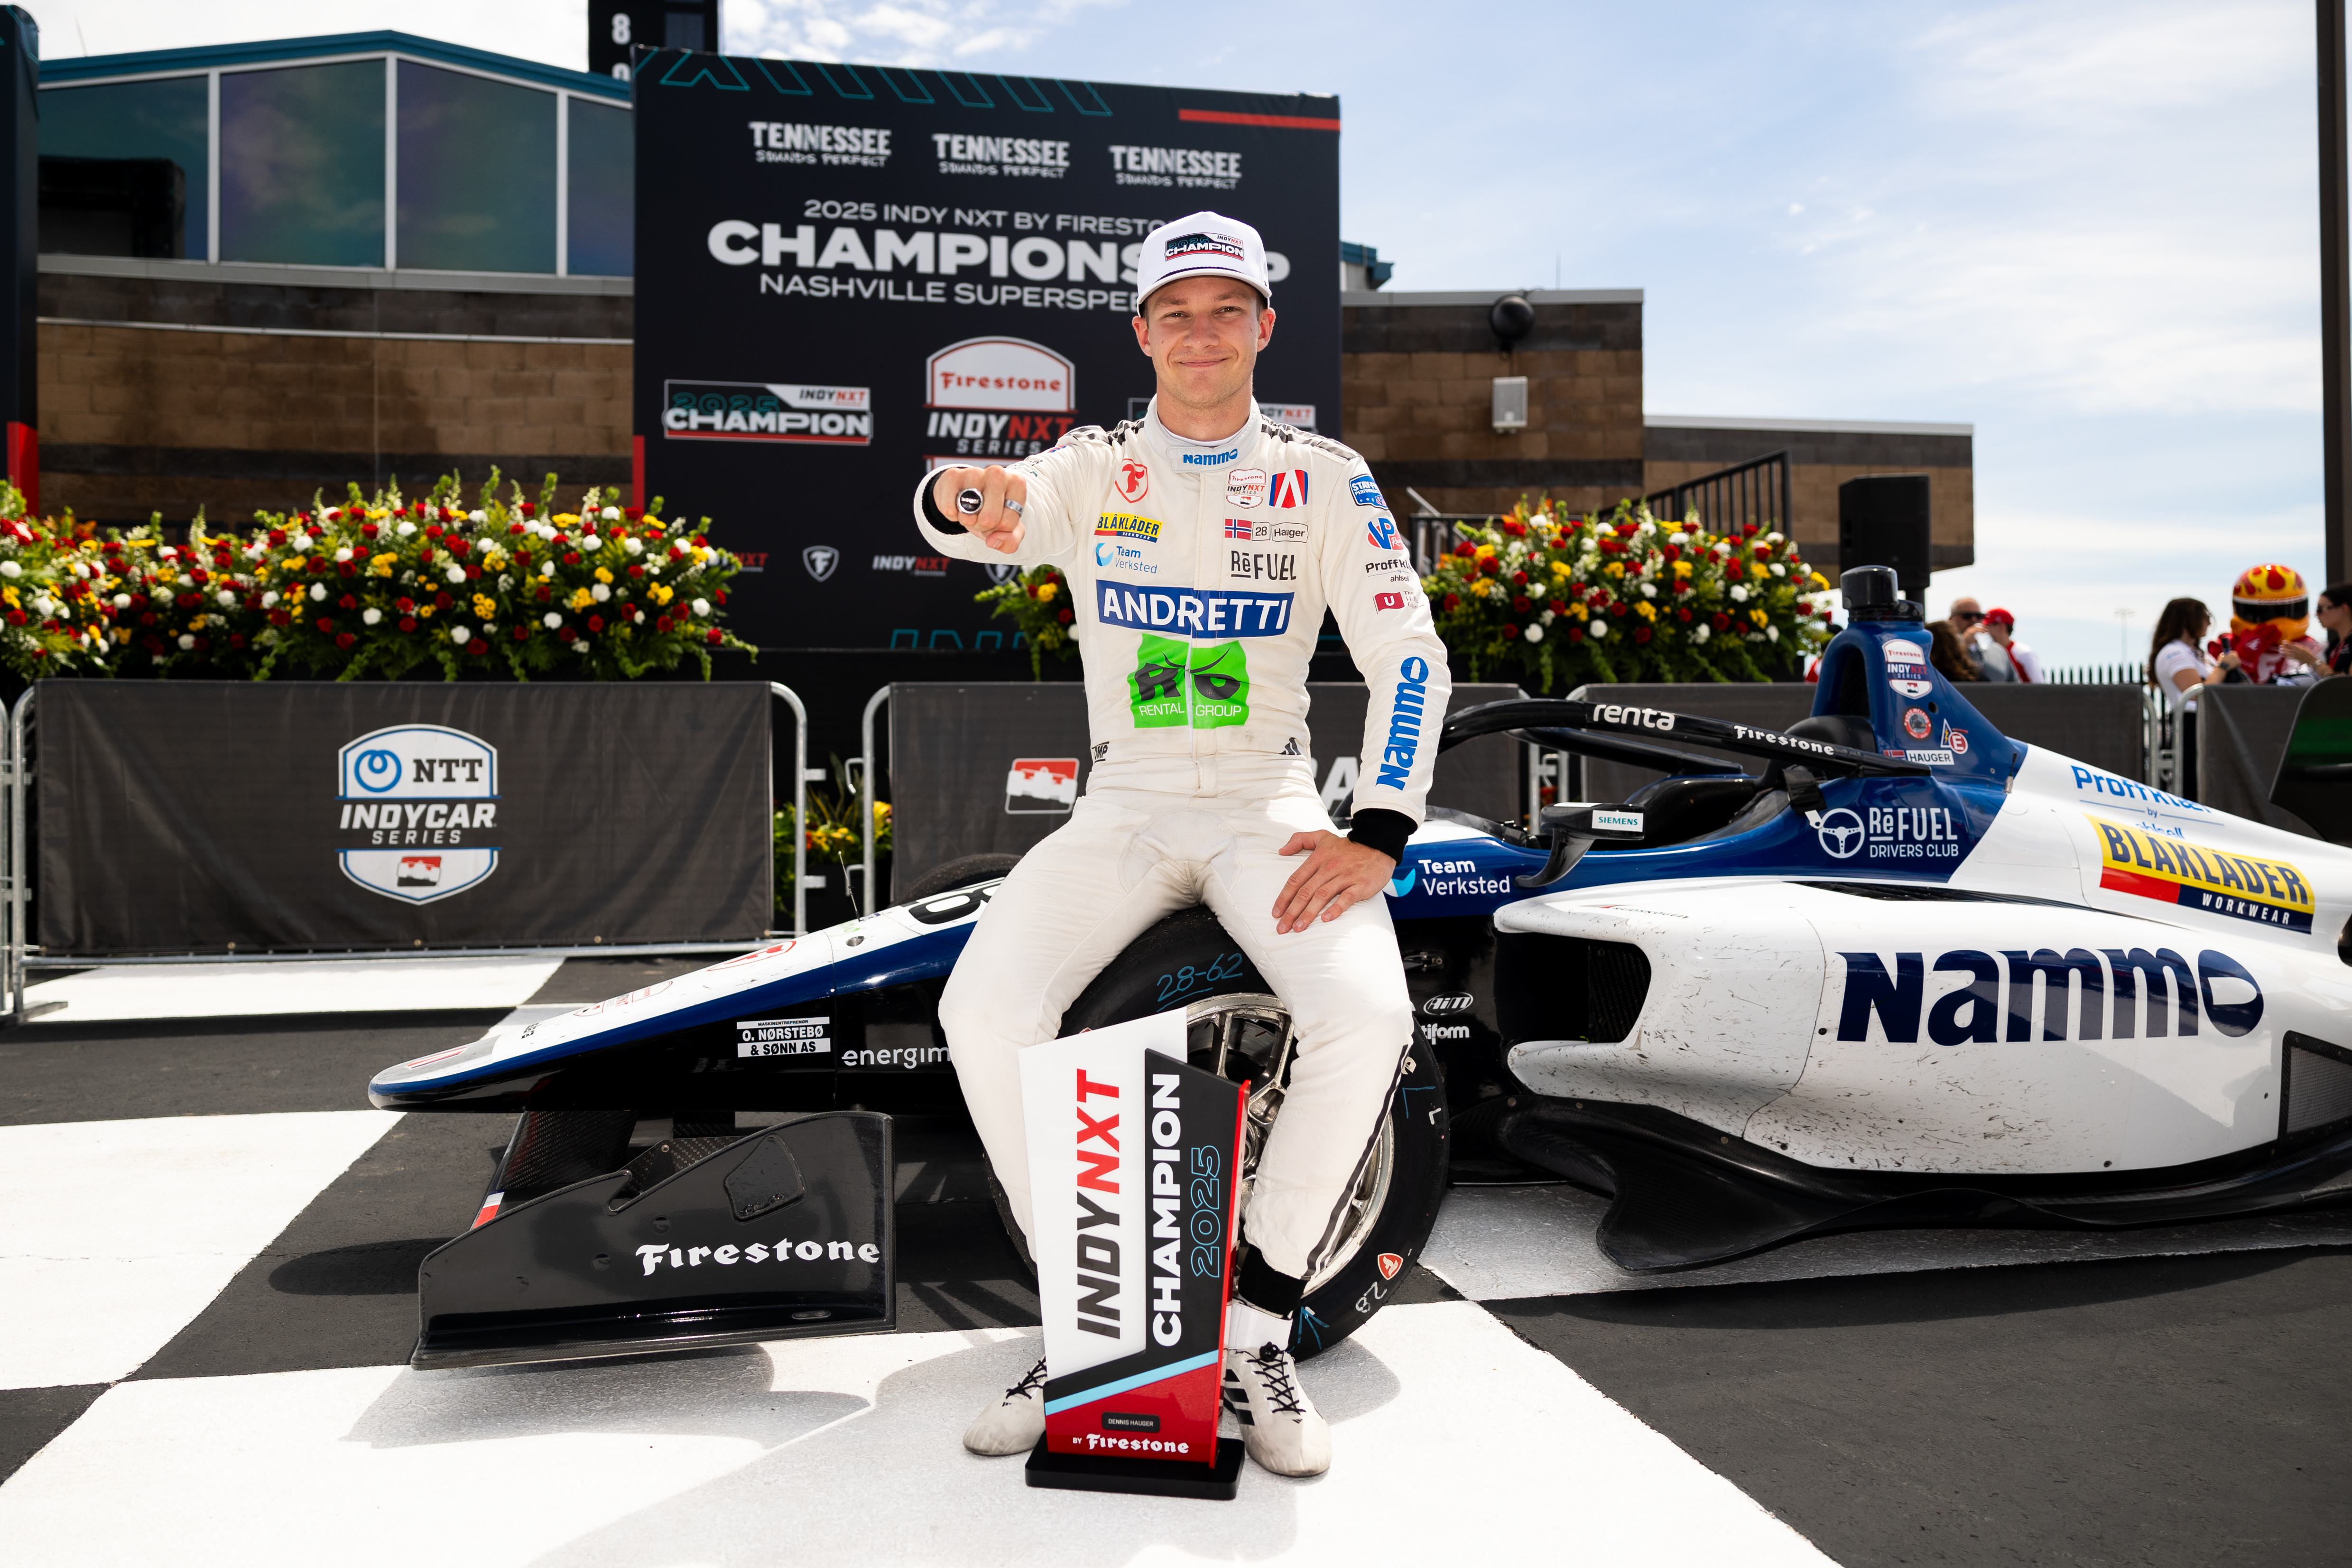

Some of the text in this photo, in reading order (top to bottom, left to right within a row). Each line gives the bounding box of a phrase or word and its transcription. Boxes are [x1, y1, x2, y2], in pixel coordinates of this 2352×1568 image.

[612, 13, 631, 45] 8
[749, 121, 892, 156] TENNESSEE
[755, 150, 888, 168] SOUNDS PERFECT
[932, 133, 1070, 167] TENNESSEE
[939, 161, 1066, 179] SOUNDS PERFECT
[1109, 145, 1242, 179] TENNESSEE
[1115, 172, 1238, 190] SOUNDS PERFECT
[804, 199, 1163, 235] 2025 INDY NXT BY FIRESTO
[1166, 242, 1244, 258] CHAMPION
[1168, 237, 1210, 249] 2025
[1217, 235, 1242, 245] INDYNXT
[707, 220, 1291, 284] CHAMPION
[760, 273, 1139, 313] NASHVILLE SUPERSPEE
[940, 371, 1062, 392] Firestone
[672, 392, 781, 417] 2025
[800, 388, 866, 400] INDYNXT
[665, 408, 869, 436] CHAMPION
[926, 412, 1074, 441] INDYNXT
[956, 439, 1042, 455] SERIES
[1183, 448, 1238, 466] Nammo
[1097, 514, 1159, 536] BLÅKLÄDER
[1255, 526, 1305, 538] 28 Hauger
[1368, 518, 1395, 549] VP
[1122, 532, 1150, 540] WORKWEAR
[1116, 546, 1141, 558] Team
[1115, 557, 1157, 574] Verksted
[1365, 559, 1413, 573] Proffkl
[1103, 588, 1288, 631] ANDRETTI
[1384, 595, 1396, 607] U
[1888, 664, 1928, 674] INDYNXT
[1139, 703, 1242, 716] RENTAL GROUP
[1593, 704, 1676, 731] renta
[1375, 657, 1429, 791] Nammo
[1733, 724, 1835, 755] Firestone
[1952, 735, 1964, 750] E
[1909, 753, 1951, 761] HAUGER
[413, 759, 482, 783] NTT
[340, 803, 496, 829] INDYCAR
[1598, 816, 1638, 826] SIEMENS
[2147, 807, 2158, 818] by
[371, 830, 462, 844] SERIES
[1870, 844, 1959, 857] DRIVERS CLUB
[1418, 859, 1476, 874] Team
[1422, 875, 1510, 896] Verksted
[2203, 892, 2290, 925] WORKWEAR
[1157, 953, 1243, 1002] 28-62
[1835, 947, 2264, 1047] Nammo
[742, 1025, 824, 1041] O. NØRSTEBØ
[1421, 1023, 1470, 1045] tiform
[750, 1041, 816, 1056] & SØNN AS
[842, 1047, 952, 1069] energim
[1077, 1068, 1120, 1340] INDYNXT
[1152, 1073, 1182, 1347] CHAMPION
[1191, 1145, 1221, 1278] 2025
[636, 1237, 880, 1276] Firestone
[1108, 1418, 1154, 1427] DENNIS HAUGER
[1086, 1433, 1190, 1454] Firestone
